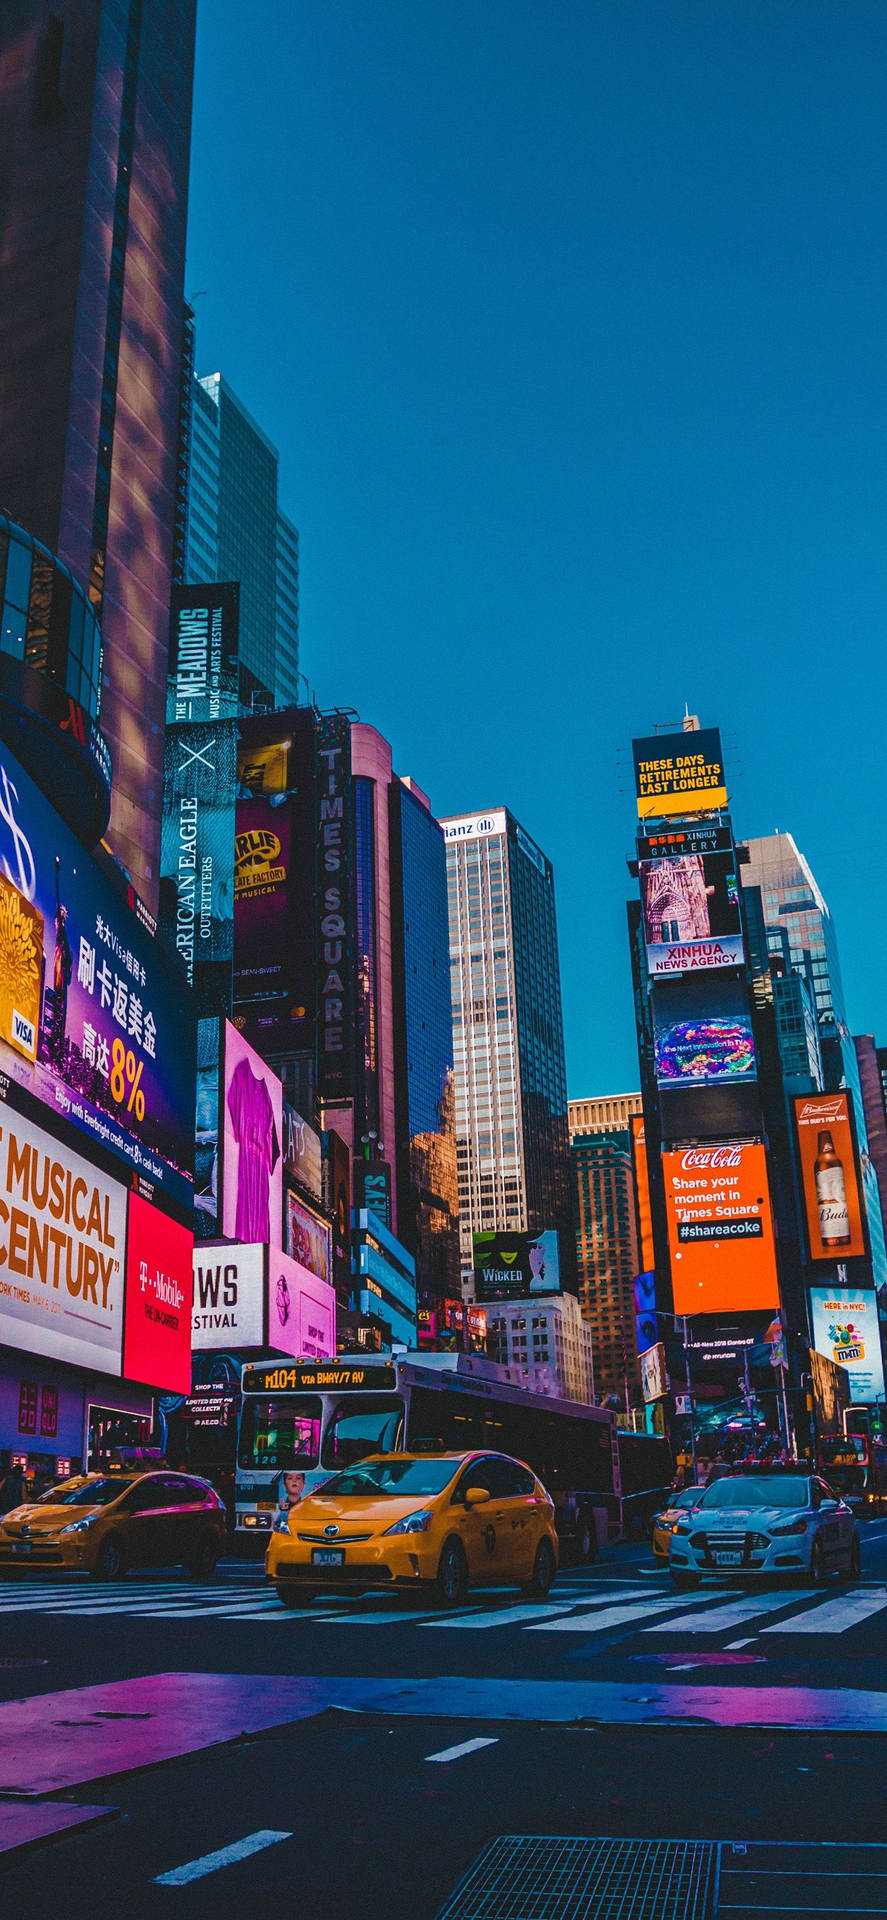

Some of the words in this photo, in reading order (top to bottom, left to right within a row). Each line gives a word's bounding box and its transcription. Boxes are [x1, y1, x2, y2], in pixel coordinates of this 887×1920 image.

[211, 607, 223, 646] FESTIVAL
[177, 608, 209, 698] MEADOWS
[211, 649, 222, 672] ARTS
[176, 702, 187, 720] THE
[209, 690, 220, 718] MUSIC
[639, 759, 674, 773] THESE
[676, 755, 705, 768] DAYS
[639, 764, 721, 784] RETIREMENTS
[640, 782, 669, 795] LAST
[673, 775, 719, 791] LONGER
[320, 749, 344, 872] TIMES
[179, 797, 198, 868] EAGLE
[445, 824, 473, 838] ianz
[686, 830, 717, 841] XINHUA
[235, 832, 275, 860] RLIE
[651, 840, 718, 856] GALLERY
[252, 868, 284, 883] FACTORY
[200, 856, 213, 939] OUTFITTERS
[667, 943, 724, 960] XINHUA
[321, 887, 347, 1052] SQUARE
[656, 959, 688, 970] NEWS
[690, 954, 737, 968] AGENCY
[78, 936, 157, 1060] 刷卡返美金
[15, 1016, 33, 1047] VISA
[55, 1086, 72, 1113] Enjoy
[72, 1102, 84, 1120] with
[84, 1109, 110, 1140] Everbright
[110, 1132, 124, 1150] credit
[143, 1157, 153, 1171] cash
[681, 1146, 744, 1170] Coca-Cola
[6, 1133, 115, 1249] MUSICAL
[673, 1177, 708, 1189] Share
[711, 1176, 739, 1188] your
[674, 1190, 726, 1204] moment
[729, 1189, 740, 1200] in
[675, 1207, 712, 1220] Times
[716, 1205, 759, 1217] Square
[680, 1222, 760, 1237] #shareacoke
[14, 1287, 30, 1303] TIMES
[192, 1264, 238, 1309] WS
[824, 1302, 841, 1311] HERE
[265, 1369, 296, 1388] M104
[301, 1375, 315, 1385] VIA
[317, 1371, 351, 1384] BWAY/7
[352, 1371, 364, 1384] AV
[185, 1398, 208, 1406] LIMITED
[209, 1397, 234, 1405] EDITON
